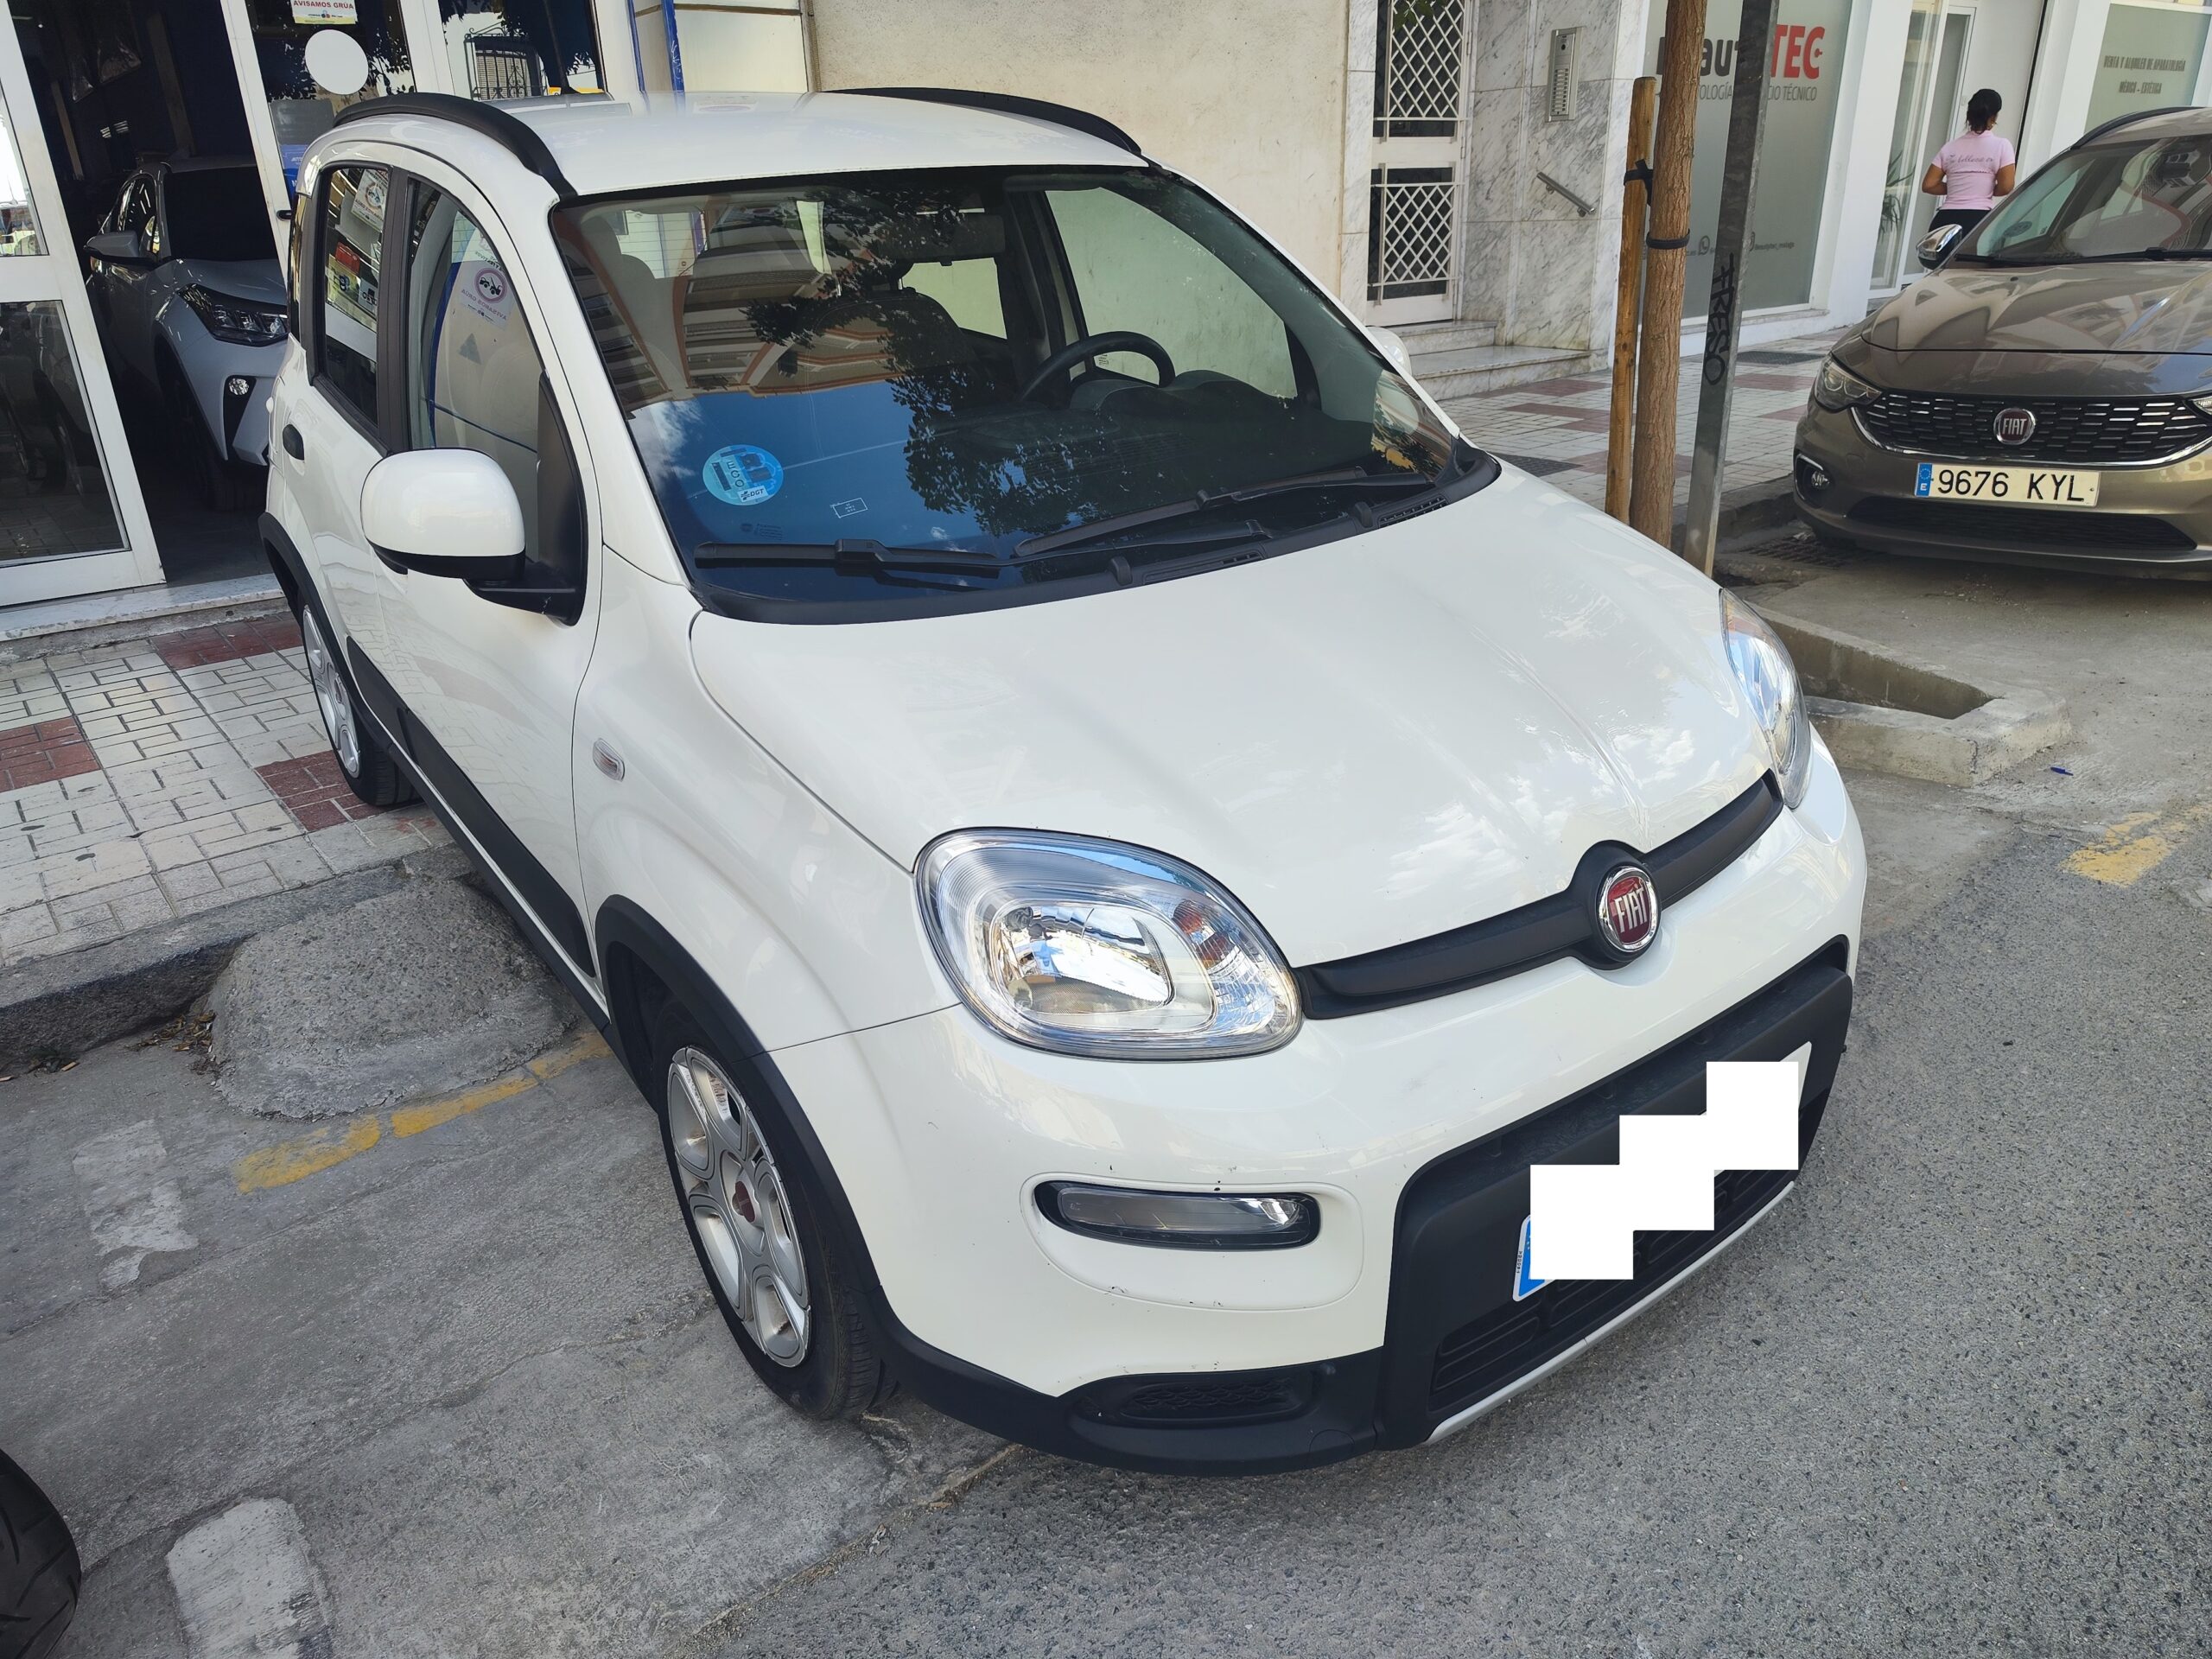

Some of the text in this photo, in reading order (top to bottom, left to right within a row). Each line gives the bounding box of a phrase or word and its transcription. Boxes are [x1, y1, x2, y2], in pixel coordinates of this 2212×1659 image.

[294, 0, 331, 9] AVISAMOS
[2104, 55, 2120, 68] VENTA
[1783, 84, 1817, 101] TÉCNICO
[2002, 418, 2027, 435] FIAT
[728, 461, 745, 487] ECO
[750, 488, 764, 497] DGT
[1937, 469, 2084, 502] 9676 KYL
[1614, 887, 1648, 933] FIAT
